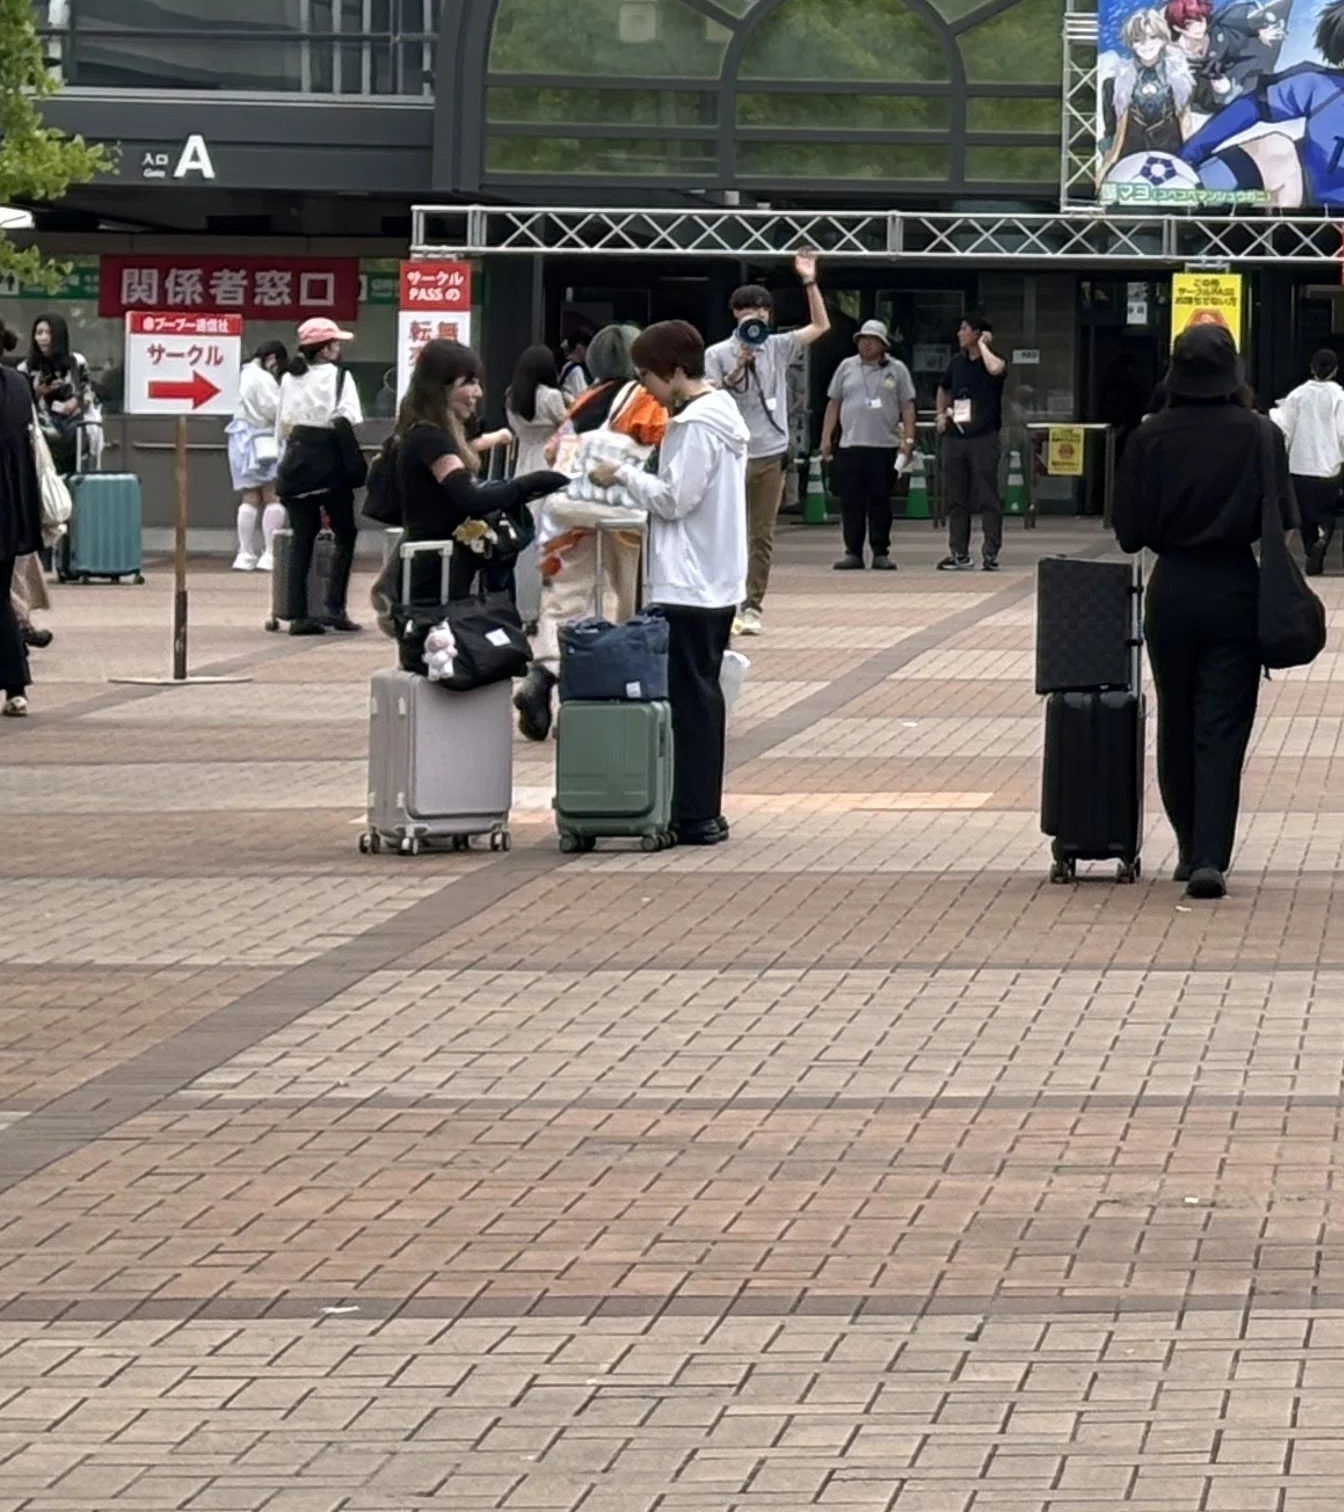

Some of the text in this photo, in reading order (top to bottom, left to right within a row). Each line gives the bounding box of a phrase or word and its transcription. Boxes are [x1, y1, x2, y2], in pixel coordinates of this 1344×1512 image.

[173, 134, 215, 179] A
[121, 268, 336, 307] 関係者窓口
[406, 270, 465, 286] サークル
[147, 343, 225, 368] サークル
